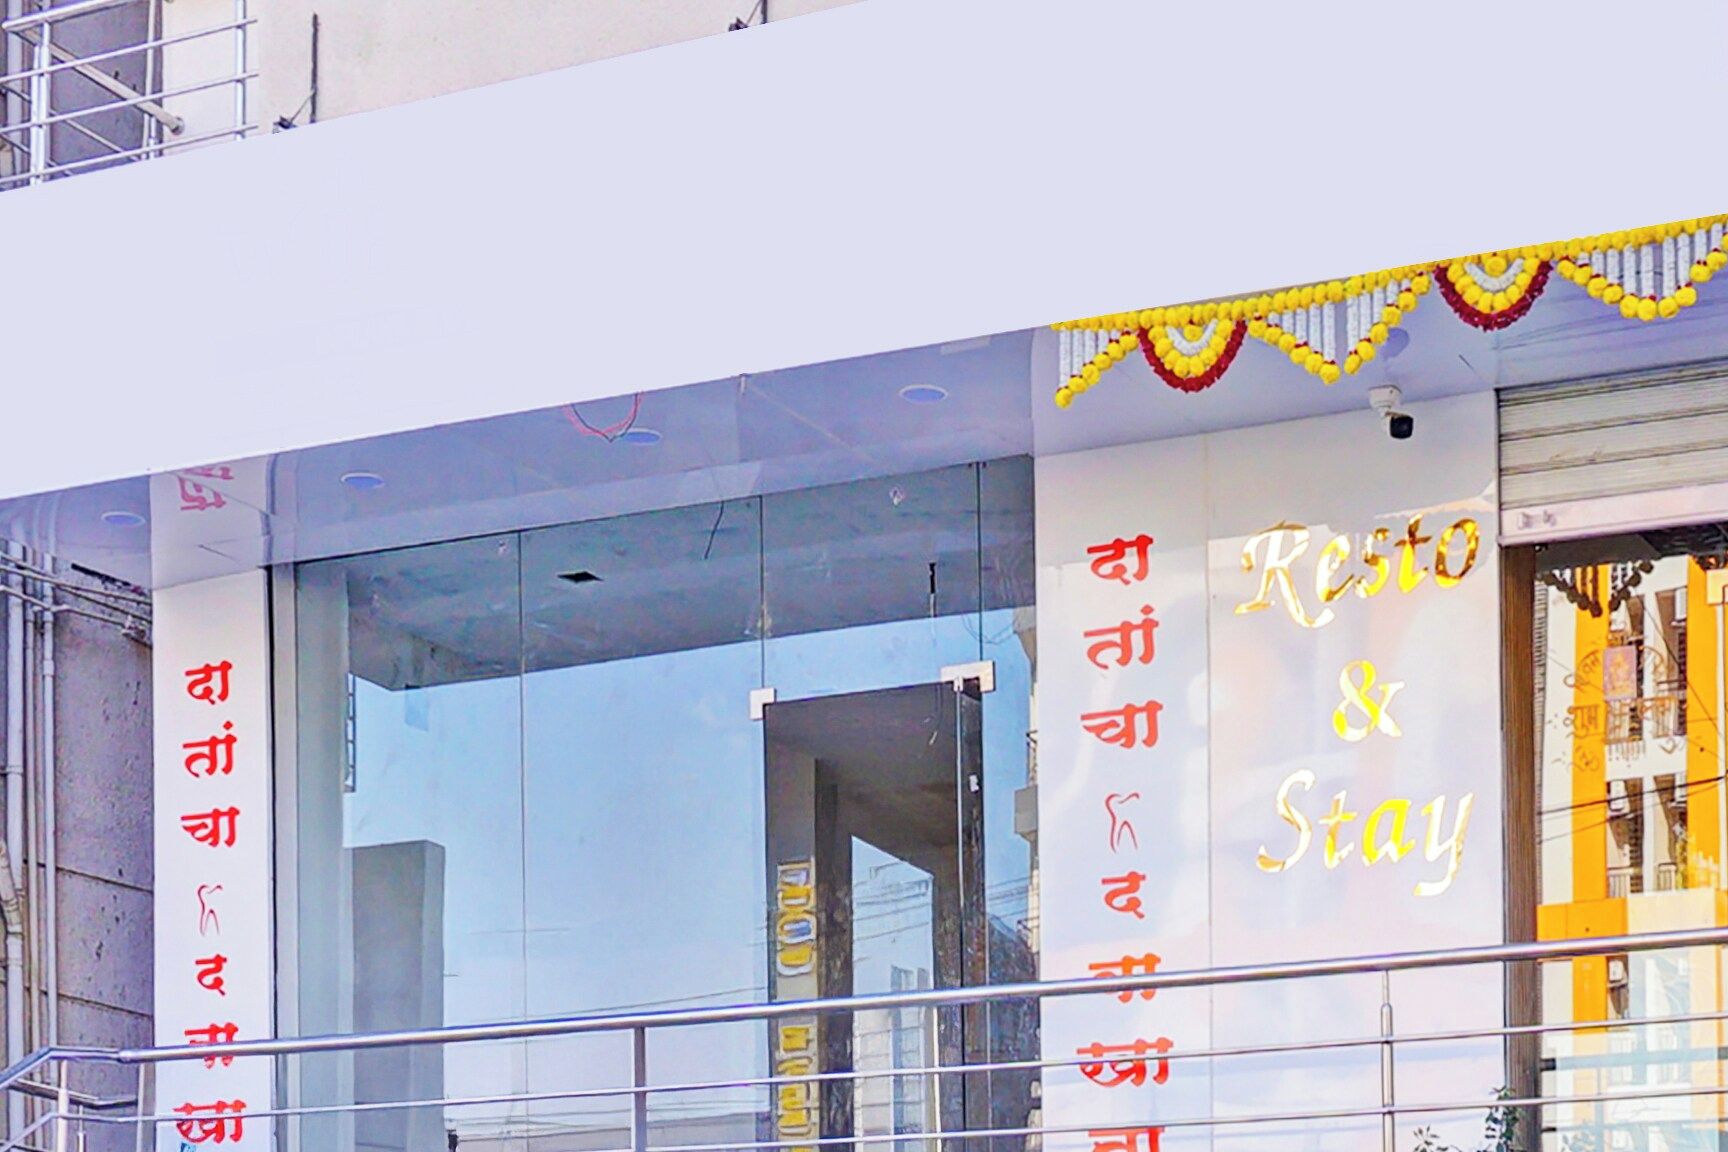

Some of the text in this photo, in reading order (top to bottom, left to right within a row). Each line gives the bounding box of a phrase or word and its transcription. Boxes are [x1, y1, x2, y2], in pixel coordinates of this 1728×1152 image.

[1234, 513, 1480, 629] Resto
[1331, 659, 1405, 742] &
[1256, 769, 1475, 897] Stay
